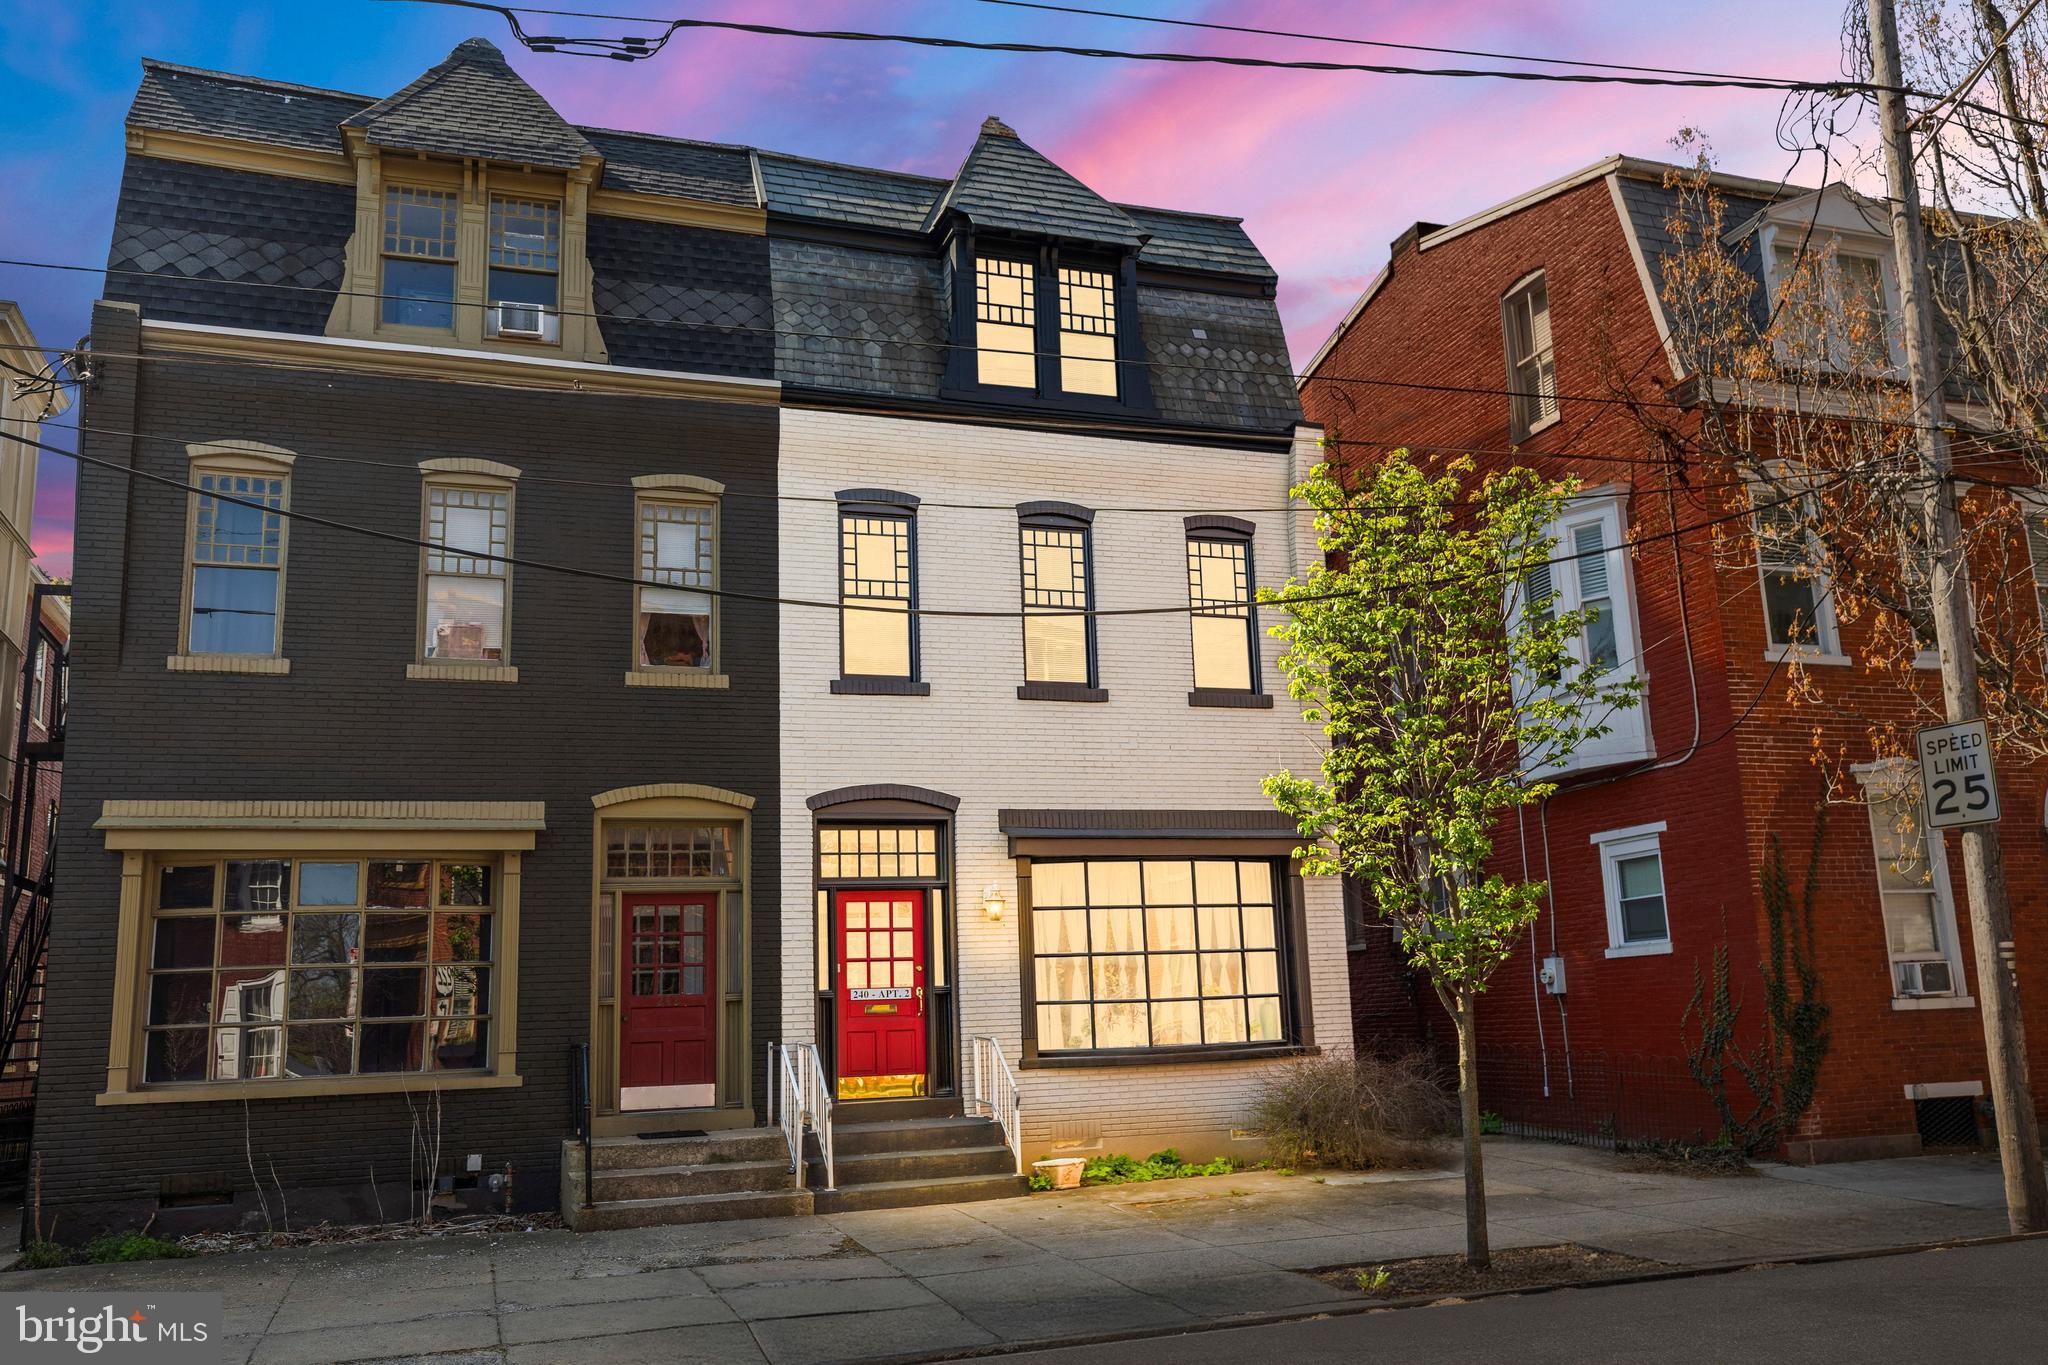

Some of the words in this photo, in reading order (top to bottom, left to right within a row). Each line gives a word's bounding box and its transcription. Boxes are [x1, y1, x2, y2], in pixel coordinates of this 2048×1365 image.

[1926, 733, 1982, 755] SPEED
[1934, 754, 1978, 774] LIMIT
[1932, 773, 1990, 815] 25
[853, 990, 869, 999] 240
[904, 989, 910, 998] 2
